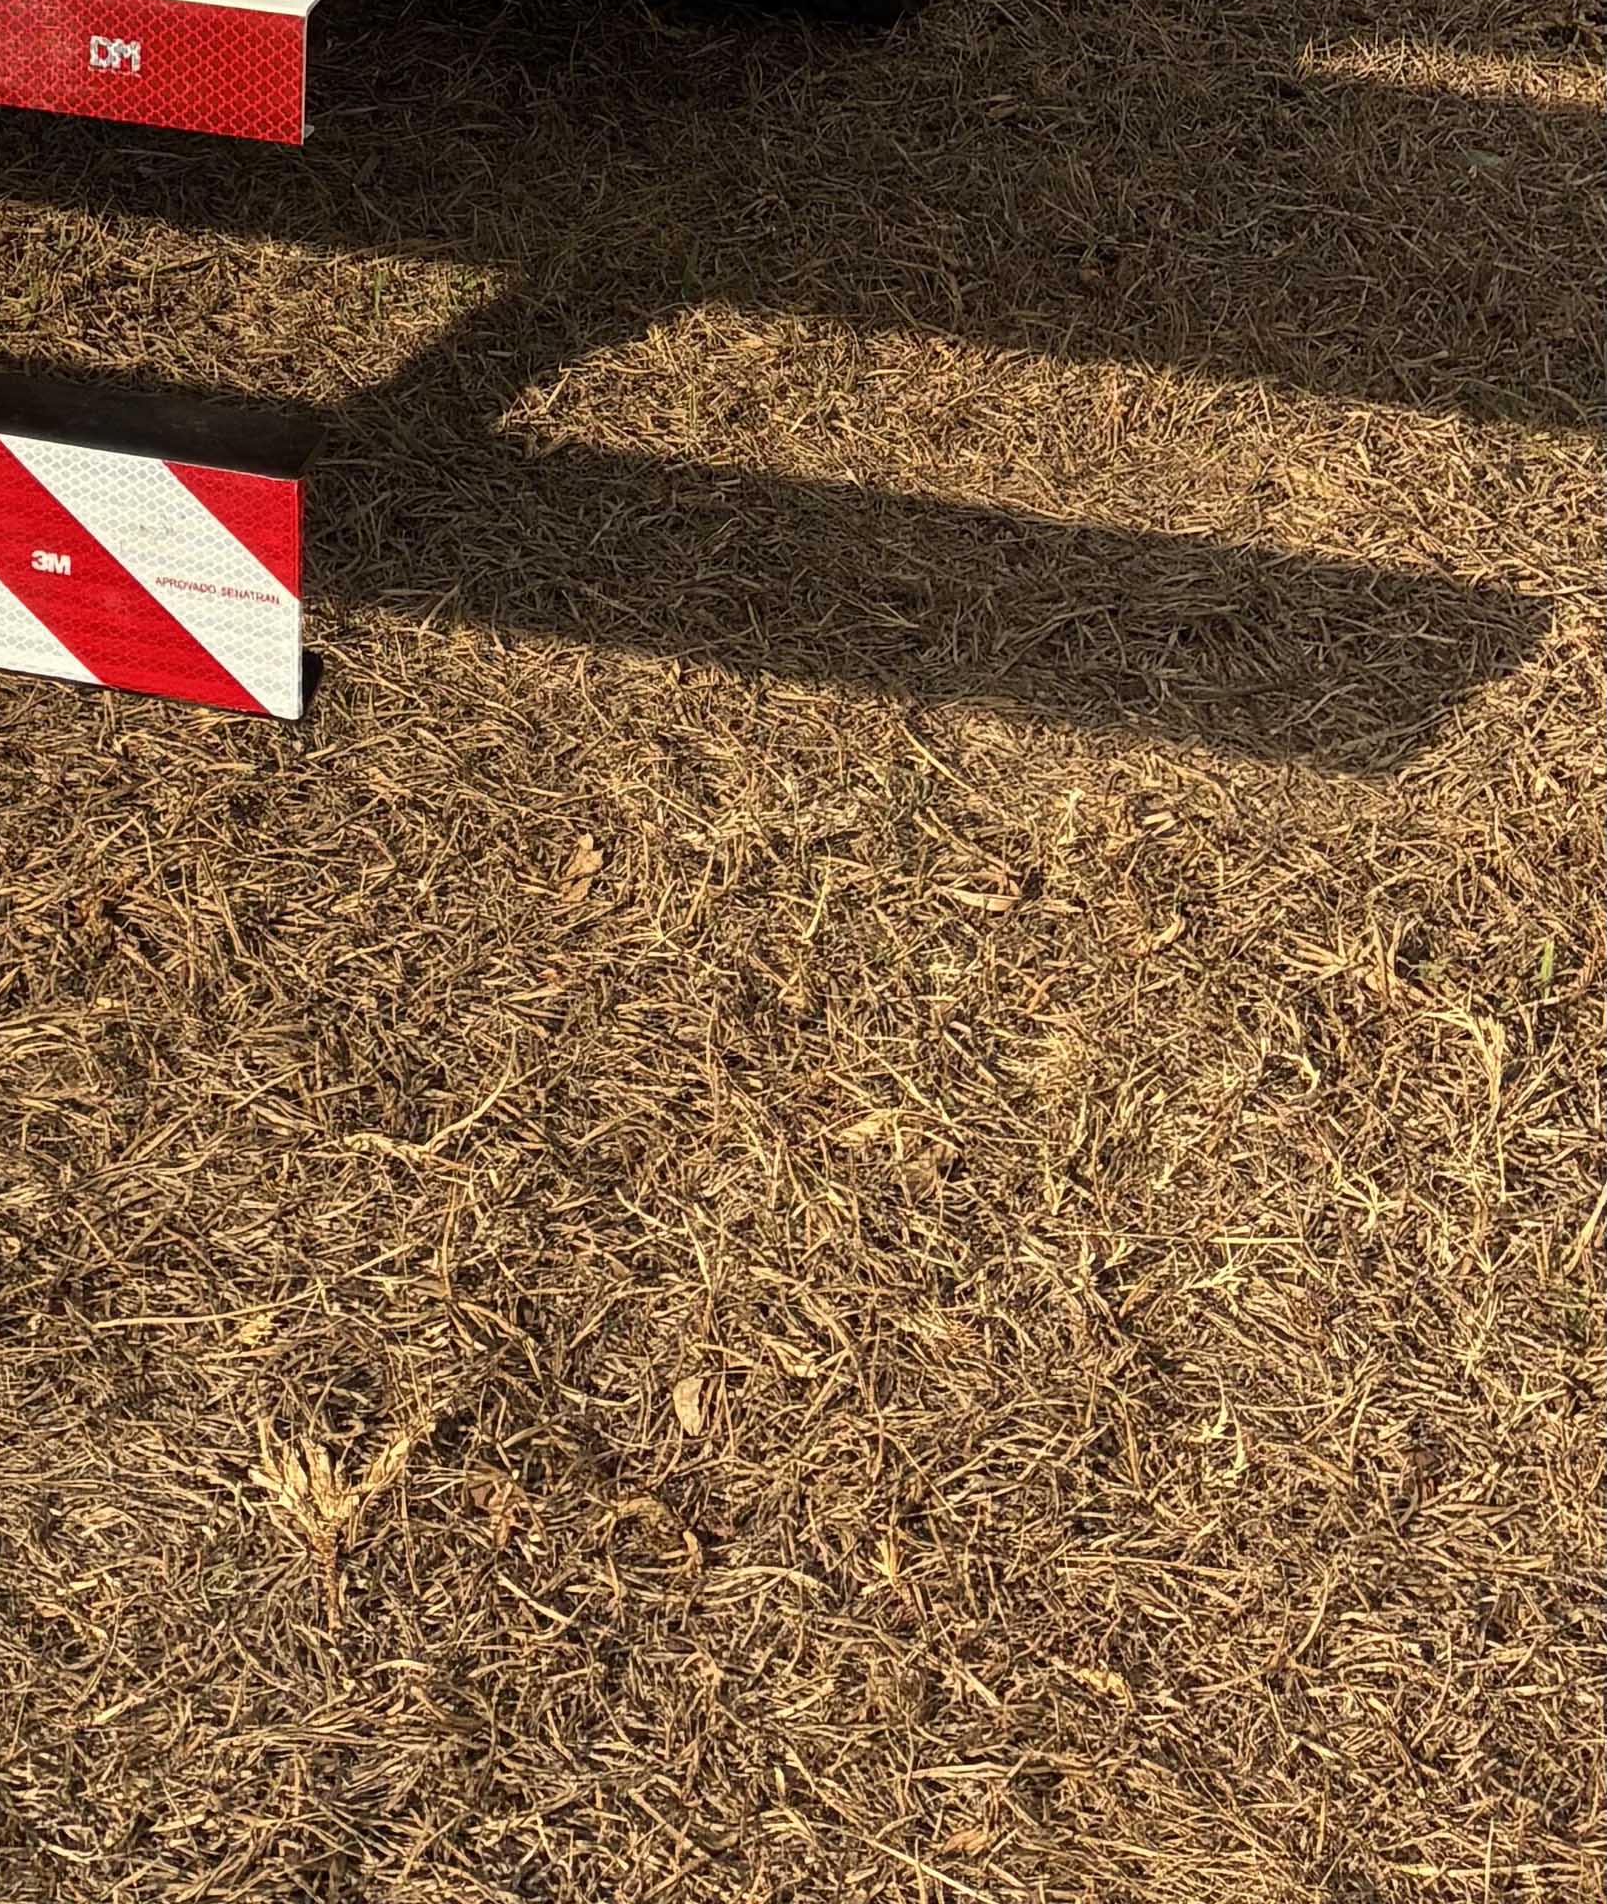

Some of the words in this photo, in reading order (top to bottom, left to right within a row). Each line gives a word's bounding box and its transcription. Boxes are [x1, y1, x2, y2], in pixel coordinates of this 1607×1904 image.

[89, 35, 141, 72] DM
[31, 550, 71, 576] 3M
[155, 576, 216, 593] APROVADO
